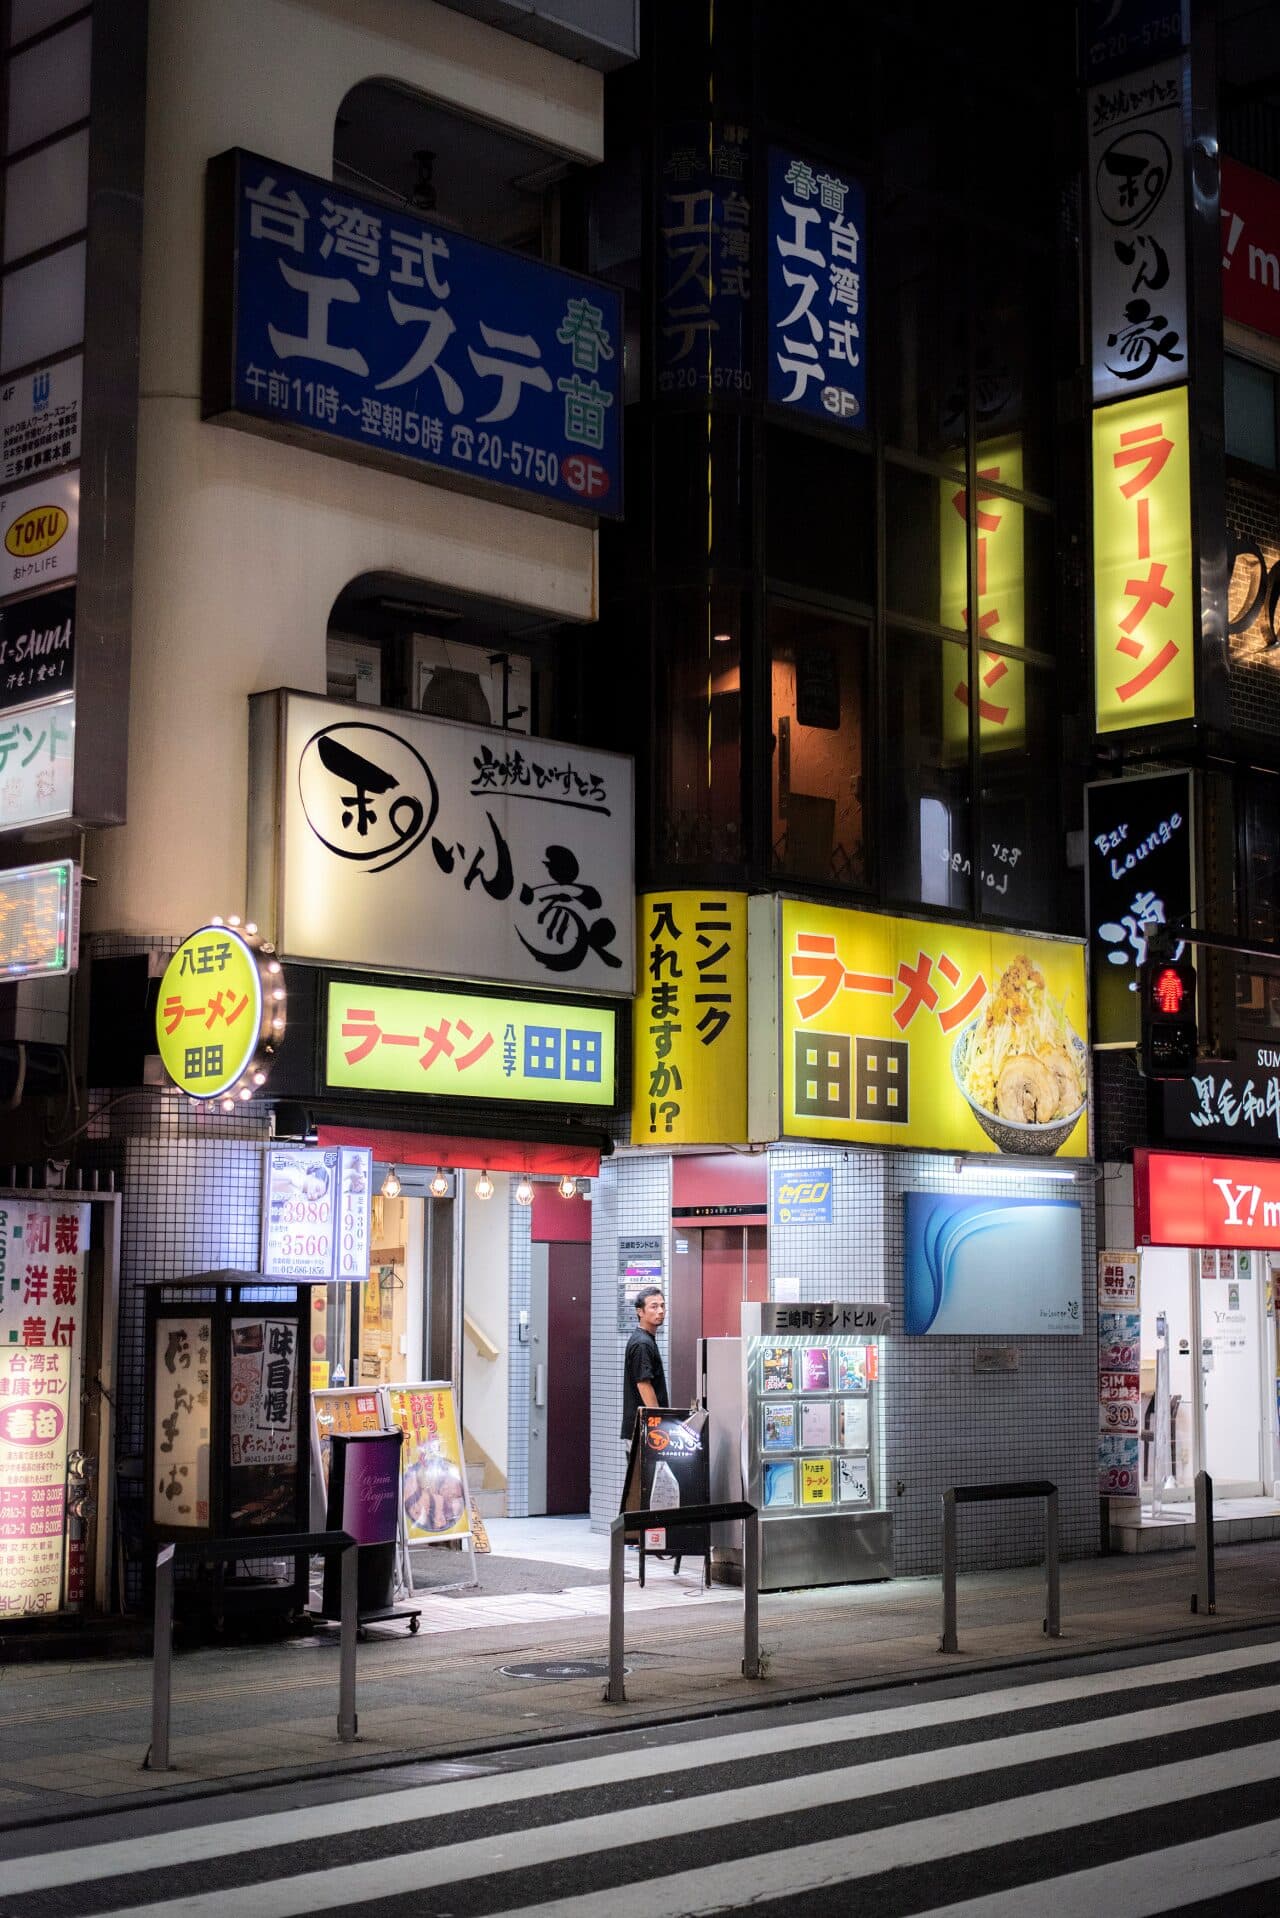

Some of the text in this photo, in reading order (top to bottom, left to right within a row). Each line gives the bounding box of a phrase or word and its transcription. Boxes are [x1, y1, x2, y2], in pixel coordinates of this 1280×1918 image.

[245, 177, 451, 299] 台湾式
[659, 188, 722, 366] エステ
[776, 195, 827, 403] エステ
[828, 214, 861, 367] 台湾式
[267, 258, 553, 424] エステ
[823, 386, 856, 417] 3F
[478, 433, 558, 486] 20-5750
[566, 458, 604, 495] 3F
[14, 513, 59, 547] TOKU
[13, 556, 57, 579] おトクLIFE
[1113, 422, 1180, 703] ラーメン
[471, 744, 608, 801] 炭焼びすとろ
[1093, 822, 1129, 857] Bar
[1109, 811, 1183, 881] Lounge
[180, 942, 232, 977] 八王子
[695, 902, 731, 1046] ニンニク
[790, 931, 988, 1033] ラーメン
[163, 989, 248, 1036] ラーメン
[184, 1044, 224, 1079] 田田
[341, 1008, 494, 1073] ラーメン
[503, 1023, 602, 1083] 八王子 田田
[794, 1029, 910, 1125] 田田
[26, 1212, 80, 1256] 和裁
[283, 1201, 330, 1224] 3980
[282, 1235, 328, 1257] 3560
[24, 1265, 78, 1307] 洋裁
[22, 1316, 76, 1346] 着付
[776, 1310, 877, 1329] 三崎町ランドビル
[9, 1353, 59, 1374] 台湾式
[264, 1325, 293, 1423] 味自慢
[1101, 1376, 1124, 1389] SIM
[648, 1417, 662, 1427] 2F
[806, 1476, 829, 1486] ラーメン
